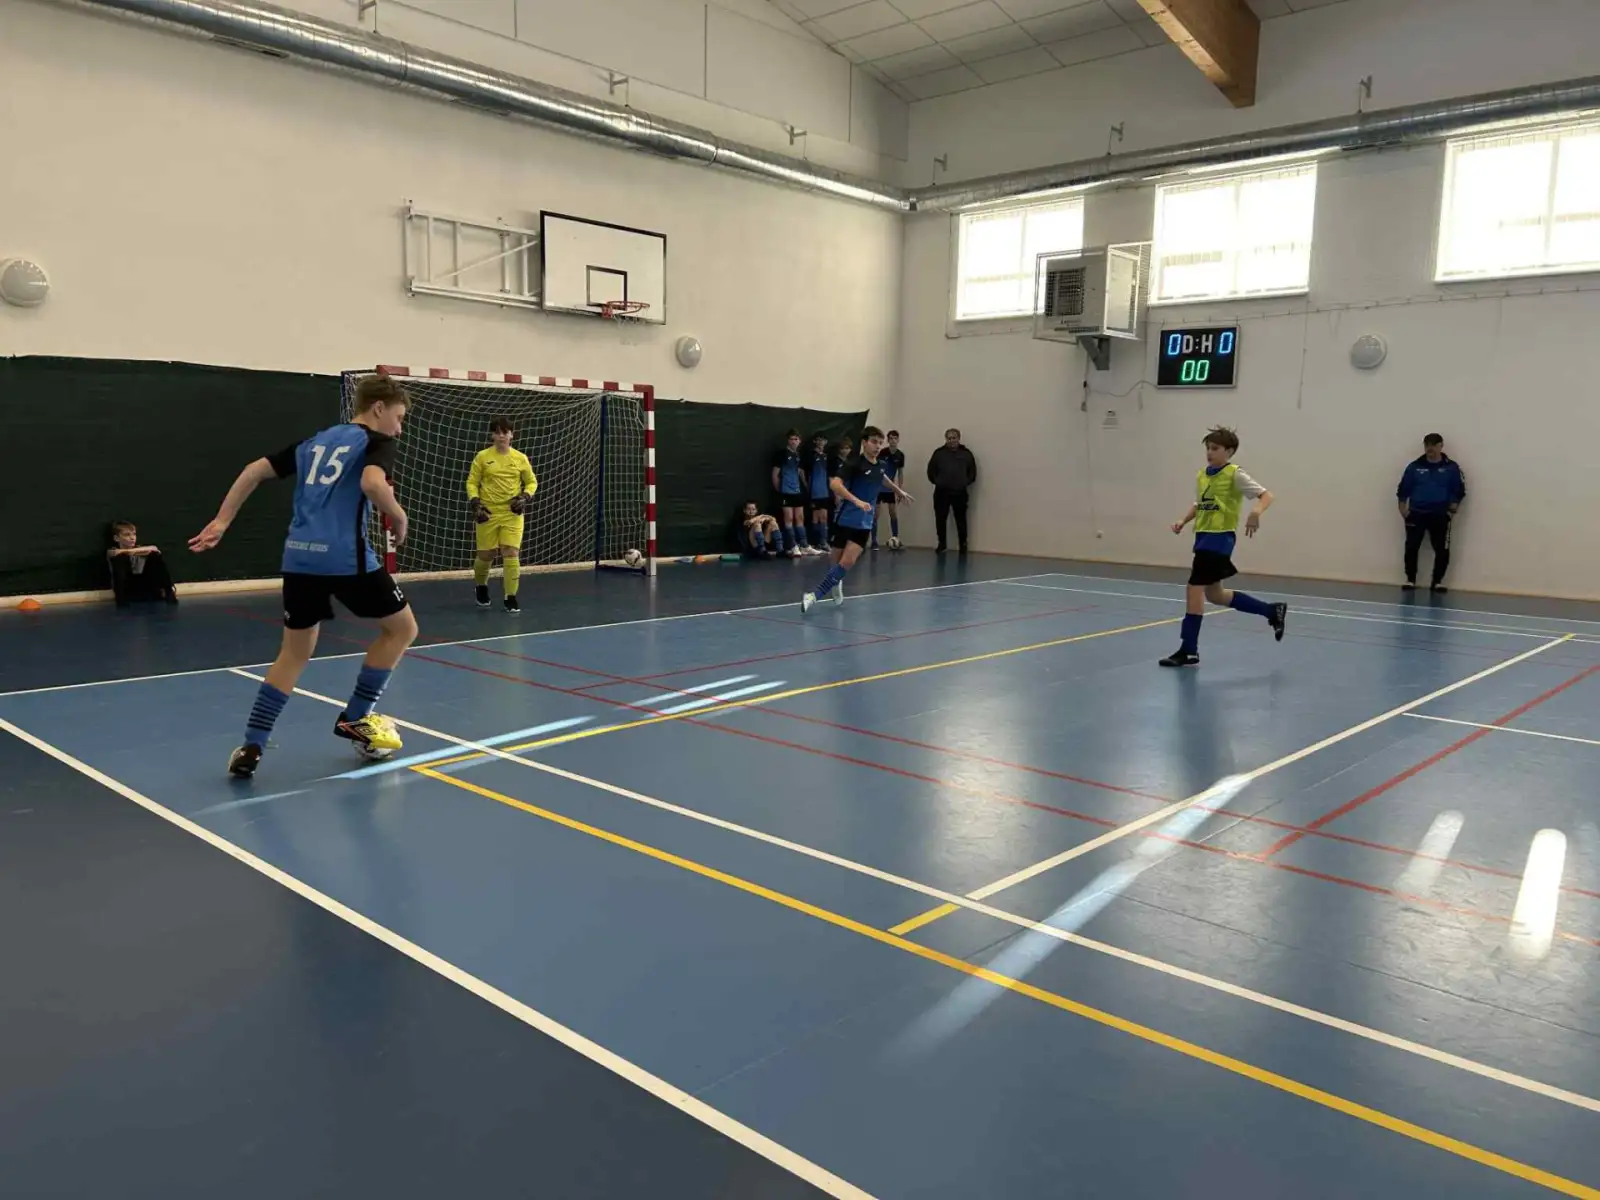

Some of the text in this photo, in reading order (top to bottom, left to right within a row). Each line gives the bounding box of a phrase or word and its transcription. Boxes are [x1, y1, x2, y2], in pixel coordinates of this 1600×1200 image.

[1168, 334, 1181, 355] 0
[1219, 332, 1233, 353] 0
[1181, 360, 1209, 381] 00
[305, 445, 350, 485] 15
